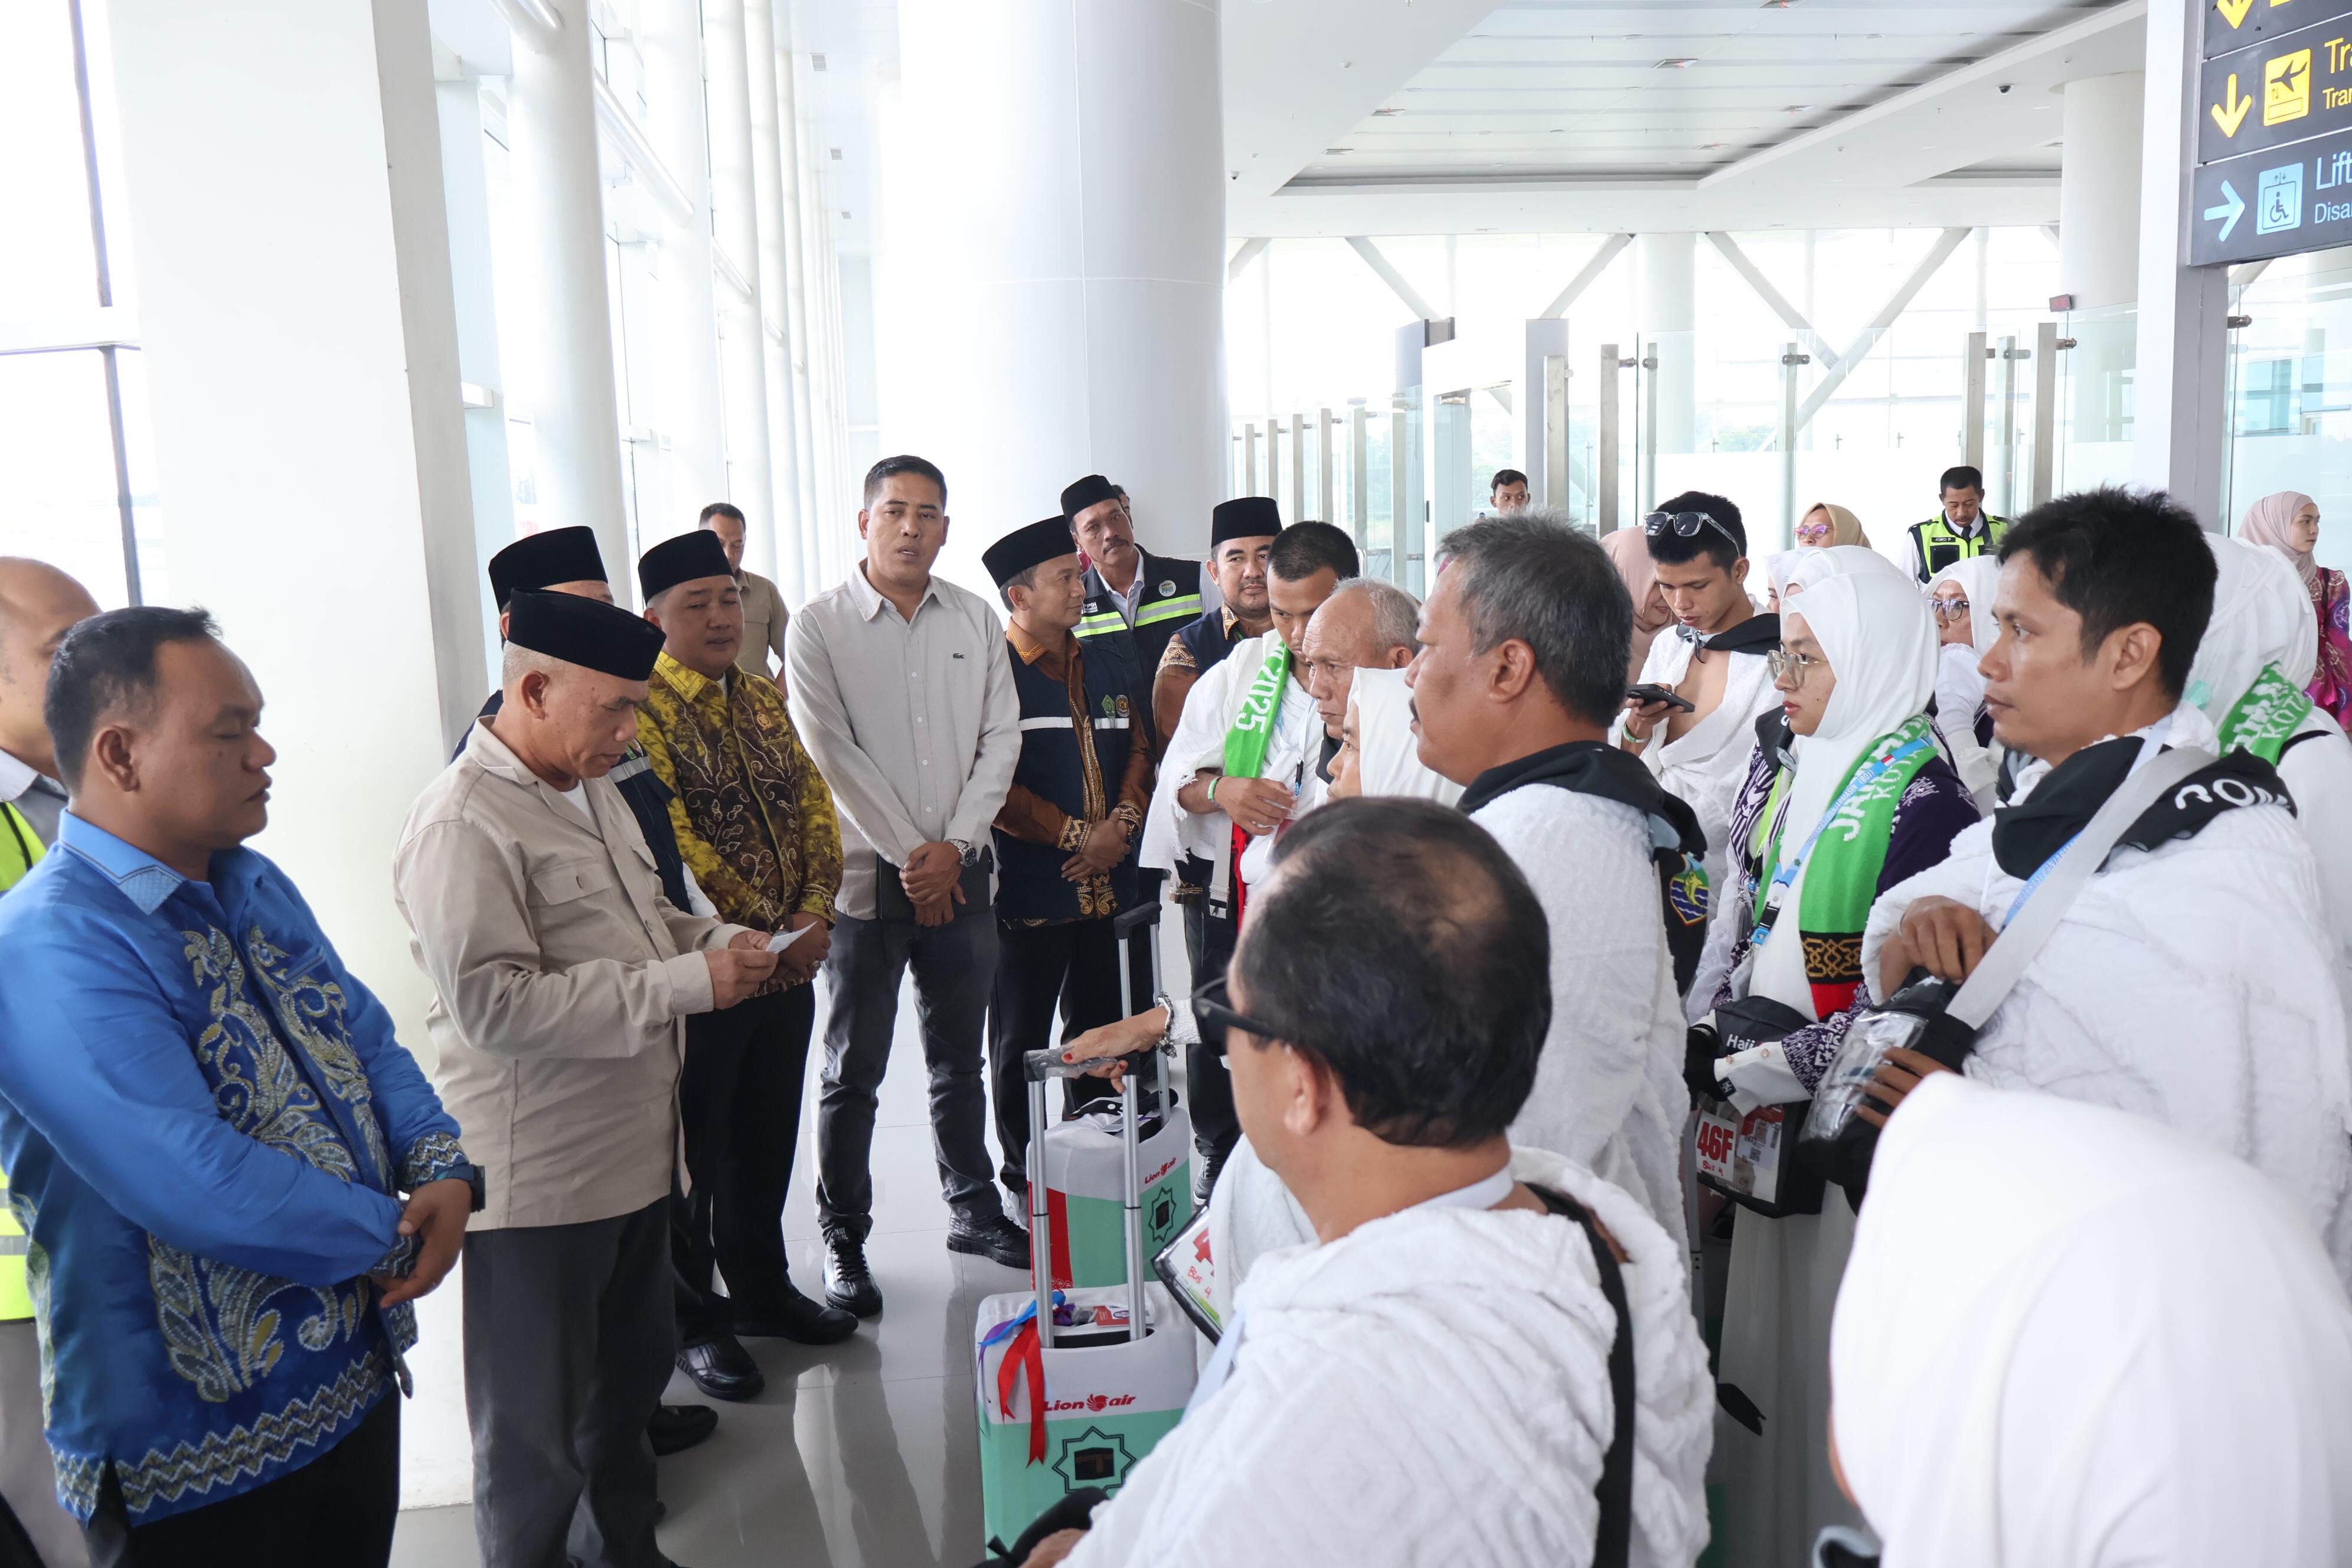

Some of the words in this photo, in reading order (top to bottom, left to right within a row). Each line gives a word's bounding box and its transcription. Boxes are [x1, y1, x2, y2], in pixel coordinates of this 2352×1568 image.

[2324, 37, 2352, 74] Tr
[2314, 198, 2352, 224] Disa
[1697, 1121, 1734, 1164] 46F
[1145, 1171, 1160, 1184] Lion
[1168, 1157, 1177, 1169] air
[1044, 1400, 1085, 1412] Lion
[1109, 1394, 1136, 1406] air
